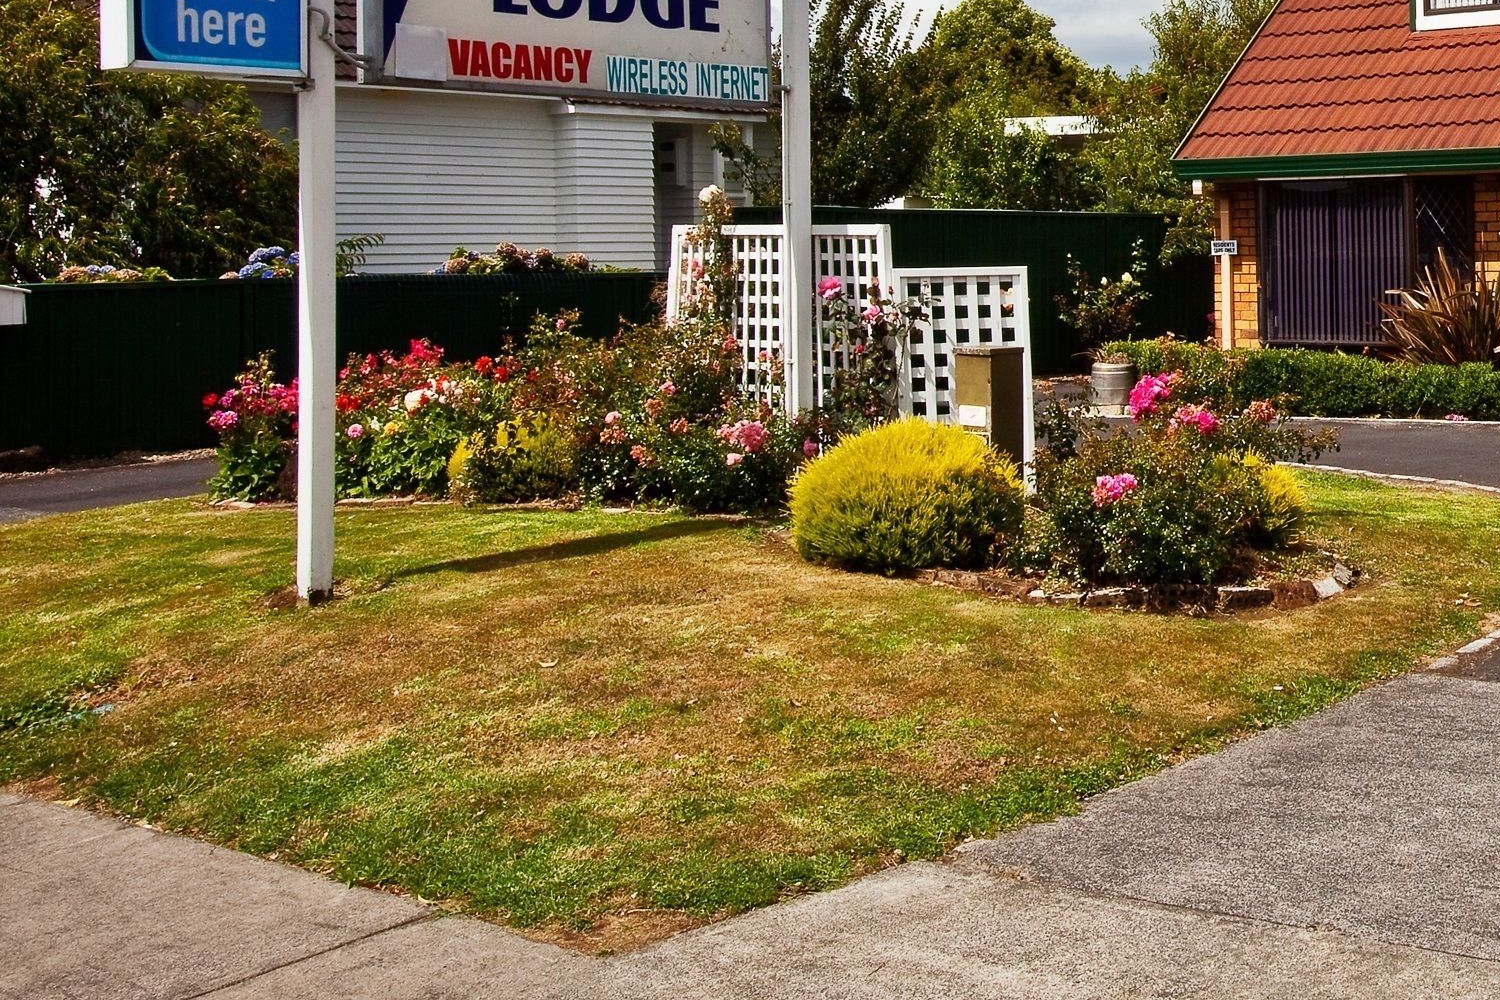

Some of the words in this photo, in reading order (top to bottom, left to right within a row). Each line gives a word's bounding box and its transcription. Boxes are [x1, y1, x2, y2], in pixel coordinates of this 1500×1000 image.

[447, 38, 593, 84] VACANCY
[606, 55, 689, 96] WIRELESS
[695, 62, 769, 102] INTERNET
